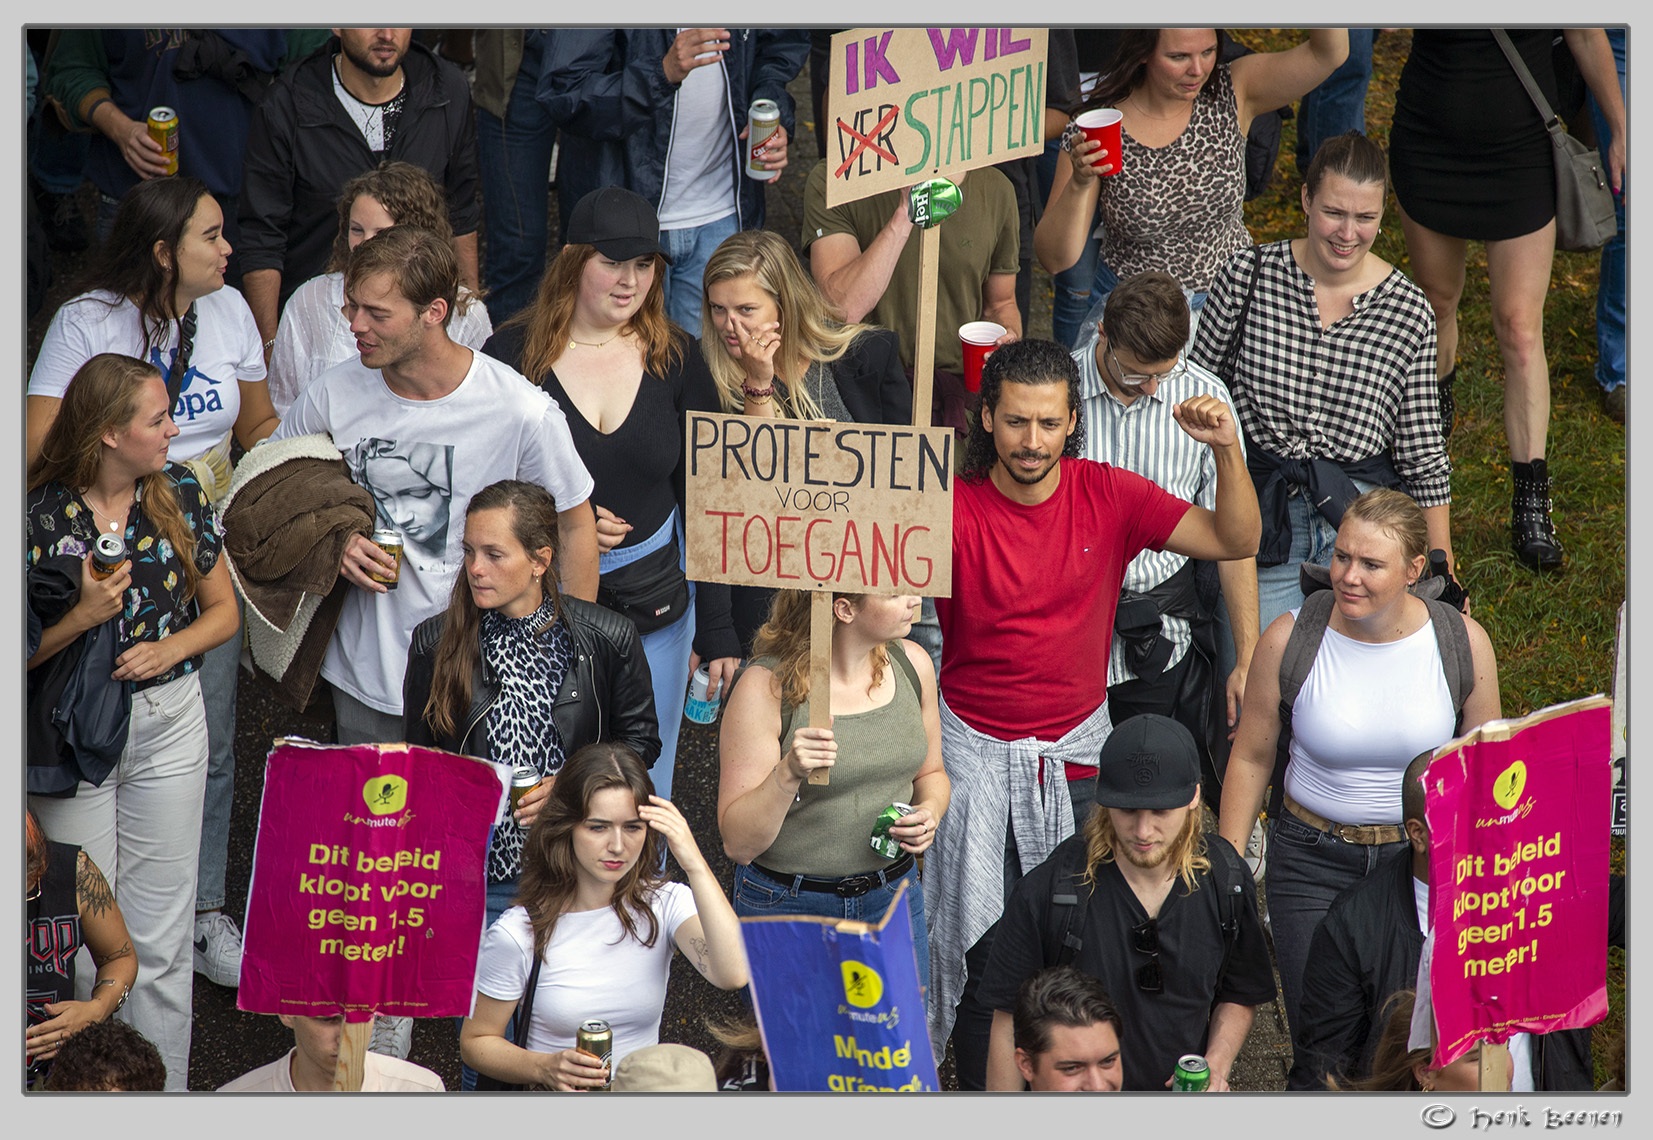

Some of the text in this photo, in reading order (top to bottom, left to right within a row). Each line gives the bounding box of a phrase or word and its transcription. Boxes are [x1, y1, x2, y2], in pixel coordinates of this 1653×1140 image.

[846, 30, 901, 95] IK
[835, 61, 1044, 181] VER STAPPEN
[691, 416, 951, 494] PROTESTEN
[775, 486, 850, 513] VOOR
[705, 510, 933, 589] TOEGANG
[308, 843, 350, 866] Dit
[1456, 832, 1561, 887] Dit beleid
[299, 873, 443, 903] klopt voor
[1453, 870, 1566, 923] klopt voor
[308, 907, 425, 931] geen 1.5
[1458, 903, 1553, 956] geen 1.5
